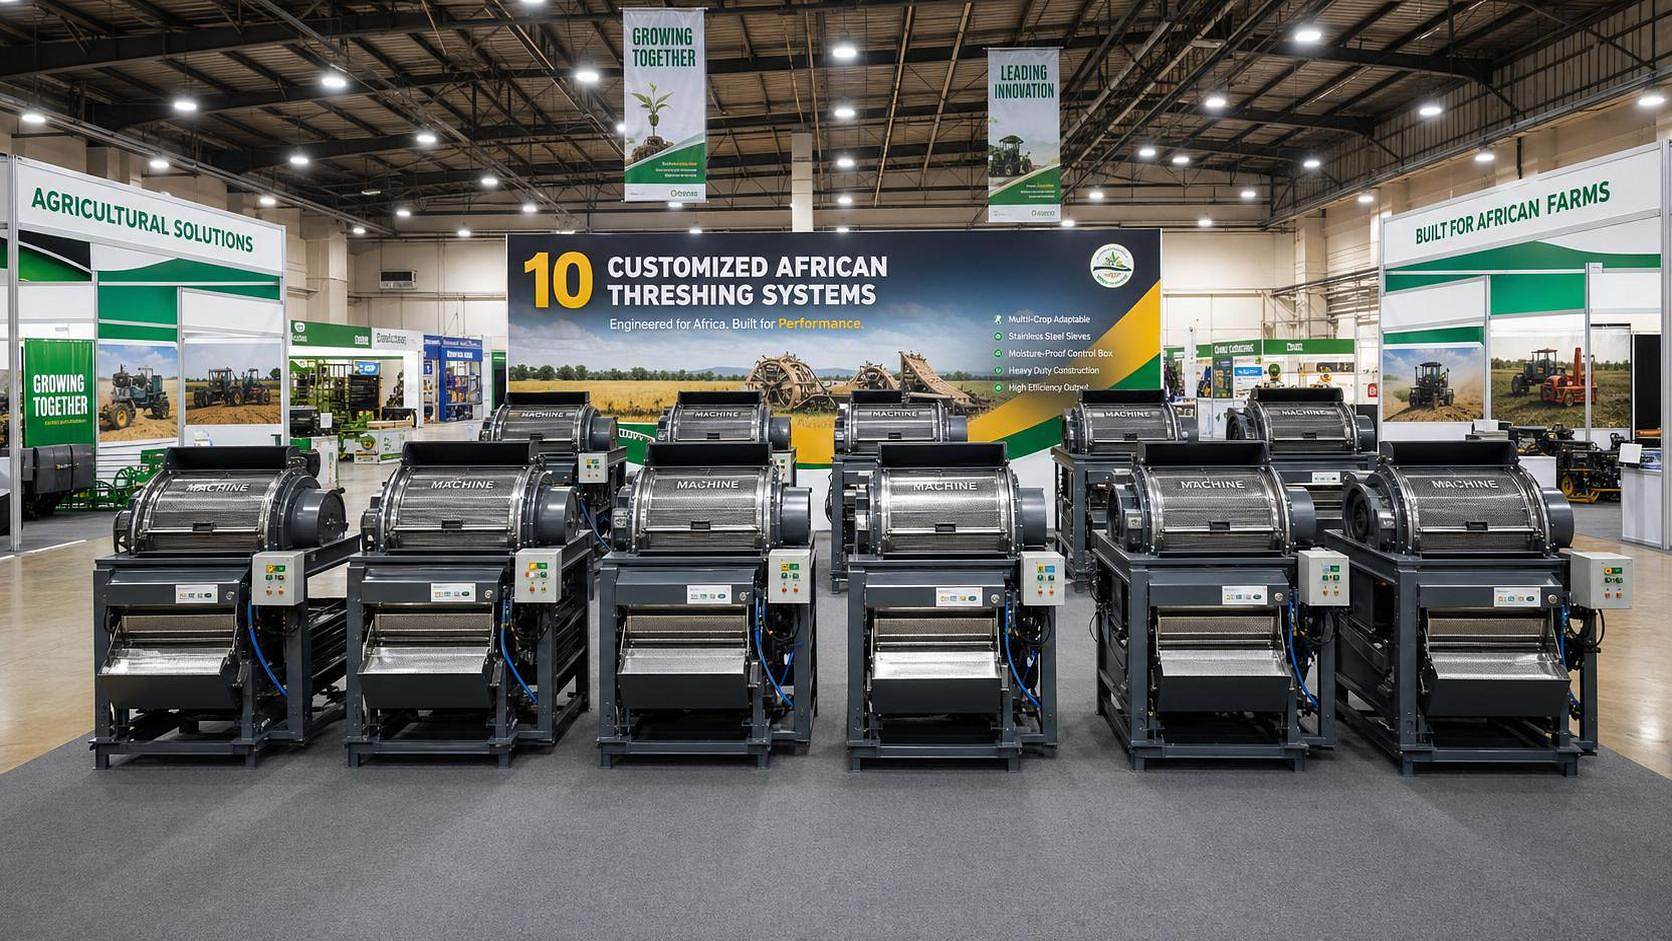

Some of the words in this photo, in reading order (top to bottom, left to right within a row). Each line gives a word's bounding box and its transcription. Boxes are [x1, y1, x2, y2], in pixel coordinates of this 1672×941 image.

[632, 27, 692, 46] GROWING
[632, 49, 696, 67] TOGETHER
[1001, 65, 1047, 81] LEADING
[994, 83, 1054, 99] INNOVATION
[1416, 222, 1447, 244] BUILT
[1450, 213, 1474, 237] FOR
[1477, 199, 1540, 230] AFRICAN
[1547, 180, 1611, 214] FARMS
[31, 187, 169, 235] AGRICULTURAL
[174, 219, 254, 252] SOLUTIONS
[607, 256, 769, 278] CUSTOMIZED
[775, 256, 888, 278] AFRICAN
[524, 252, 593, 309] 10
[607, 284, 753, 306] THRESHING
[761, 284, 876, 305] SYSTEMS
[610, 318, 673, 332] Engineered
[676, 318, 692, 330] for
[693, 318, 729, 331] Africa.
[732, 318, 756, 330] Built
[759, 318, 775, 330] for
[778, 318, 864, 330] Performance.
[1053, 314, 1090, 326] Adaptable
[1008, 332, 1043, 341] Stainless
[1044, 332, 1065, 341] Steel
[1066, 332, 1091, 341] Sieves
[1008, 349, 1066, 358] Moisture-Proof
[1068, 349, 1096, 358] Control
[1098, 349, 1113, 358] Box
[1008, 366, 1032, 376] Heavy
[1033, 366, 1052, 376] Duty
[1053, 365, 1100, 375] Construction
[33, 374, 85, 393] GROWING
[1008, 383, 1027, 393] High
[33, 394, 88, 418] TOGETHER
[695, 410, 740, 418] MACHINE
[872, 410, 918, 418] MACHINE
[1281, 410, 1328, 418] MACHINE
[185, 483, 249, 493] MACHINE
[431, 480, 494, 490] MACHINE
[677, 480, 740, 490] MACHINE
[913, 481, 978, 491] MACHINE
[1180, 480, 1246, 490] MACHINE
[1432, 479, 1500, 490] MACHINE
